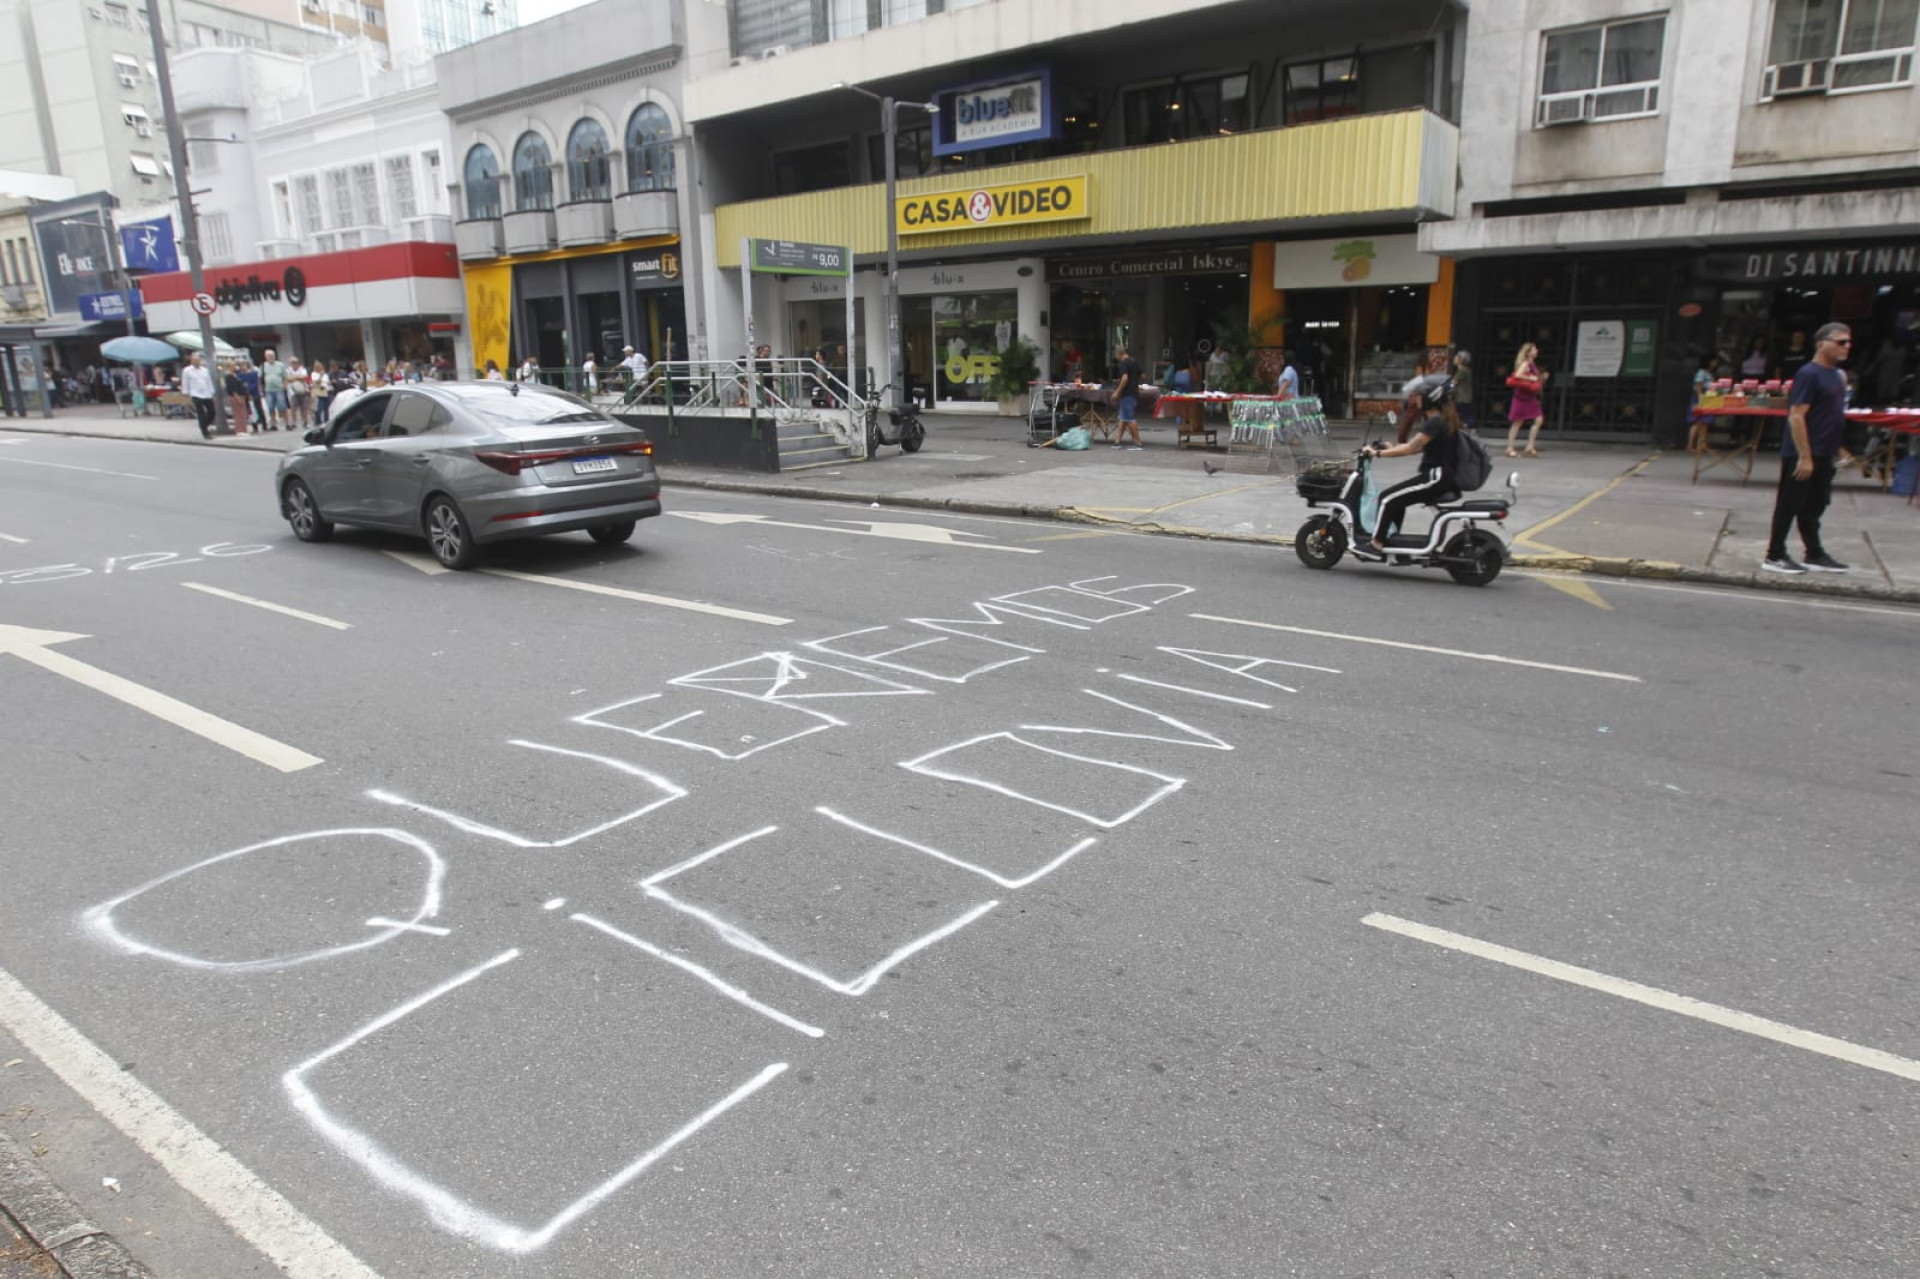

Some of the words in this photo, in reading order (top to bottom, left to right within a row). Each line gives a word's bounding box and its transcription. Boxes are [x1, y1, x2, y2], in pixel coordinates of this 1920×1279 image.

[903, 197, 968, 226] CASA
[993, 185, 1072, 216] VIDEO
[819, 252, 840, 268] 9,00
[1058, 263, 1104, 277] Centro
[1110, 256, 1184, 274] Comercial
[1745, 253, 1773, 278] DI
[1782, 246, 1920, 278] SANTINN
